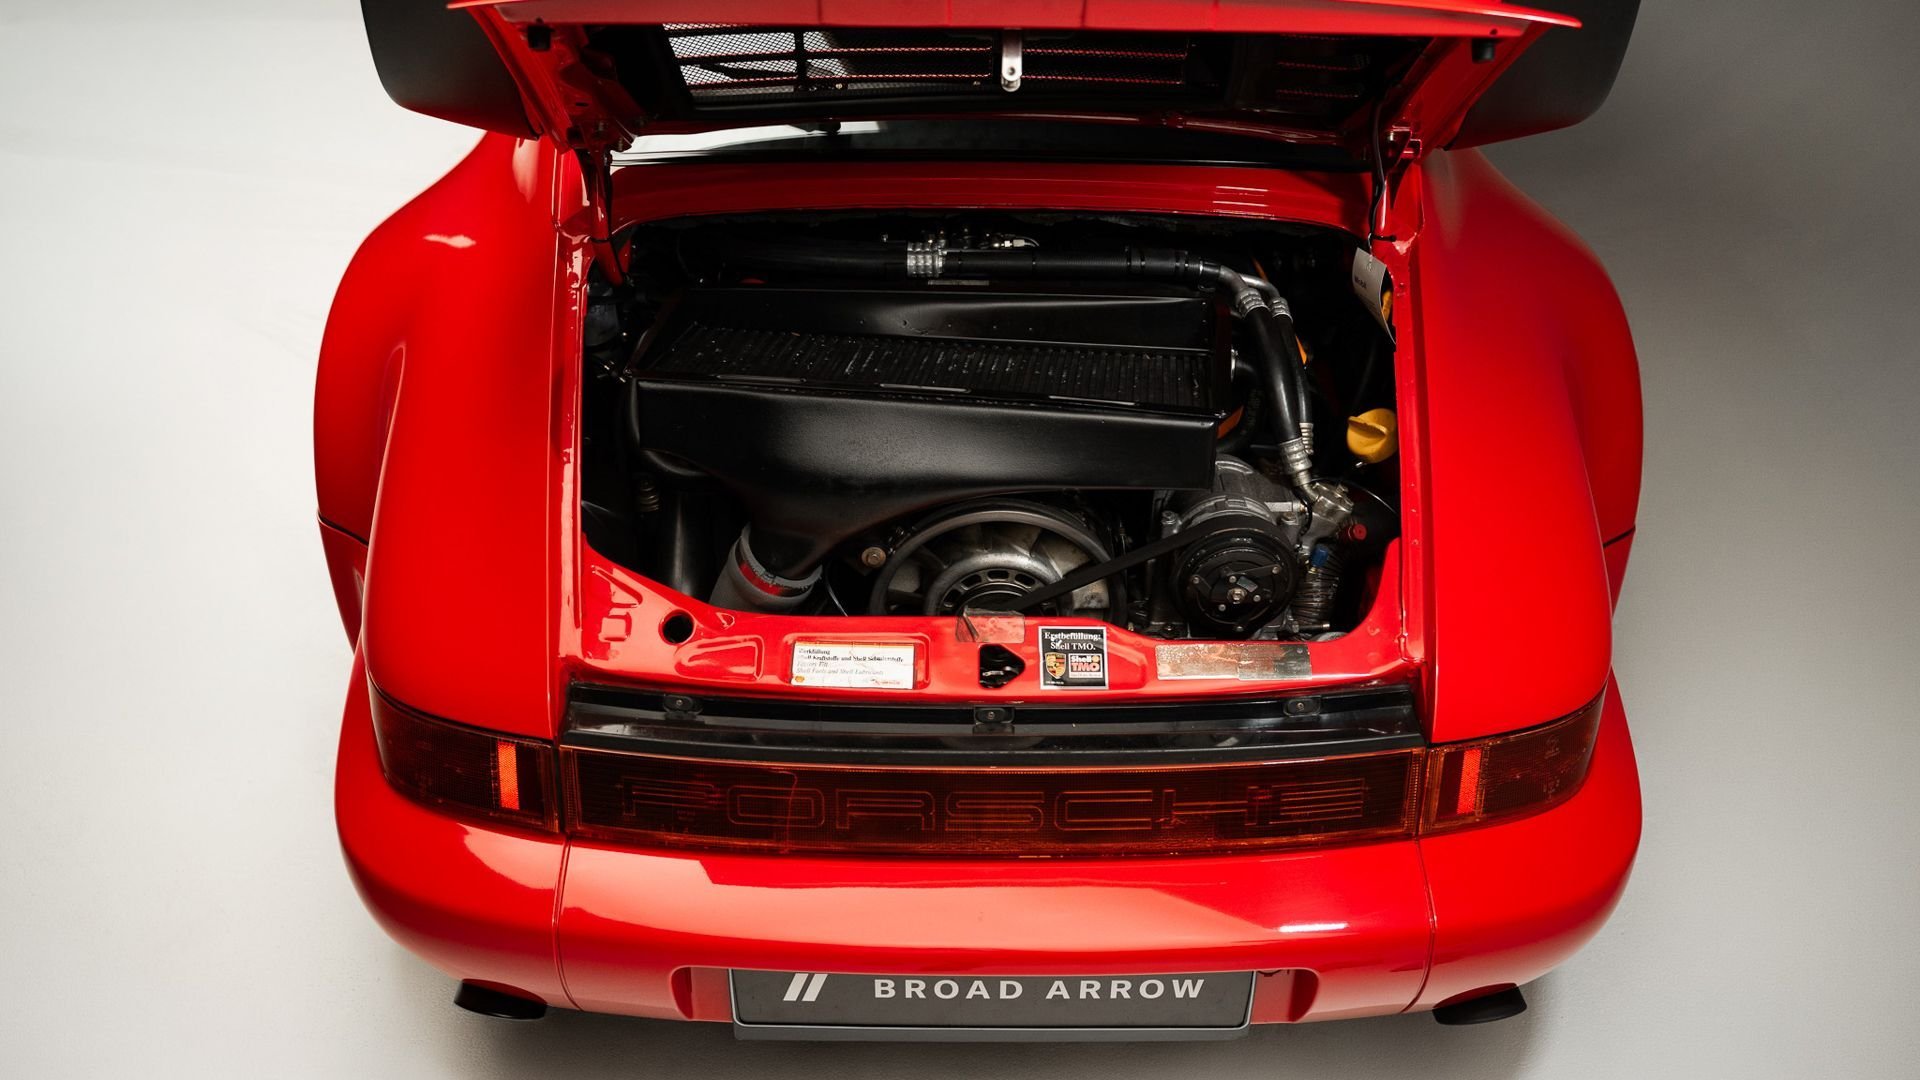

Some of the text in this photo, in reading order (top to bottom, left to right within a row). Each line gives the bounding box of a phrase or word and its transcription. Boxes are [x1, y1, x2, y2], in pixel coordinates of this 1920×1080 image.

[1071, 642, 1096, 650] TMO.
[1071, 655, 1092, 663] Shell
[1071, 662, 1100, 672] TMO
[622, 777, 1367, 832] PORSCHE
[874, 978, 1205, 999] BROAD ARROW
